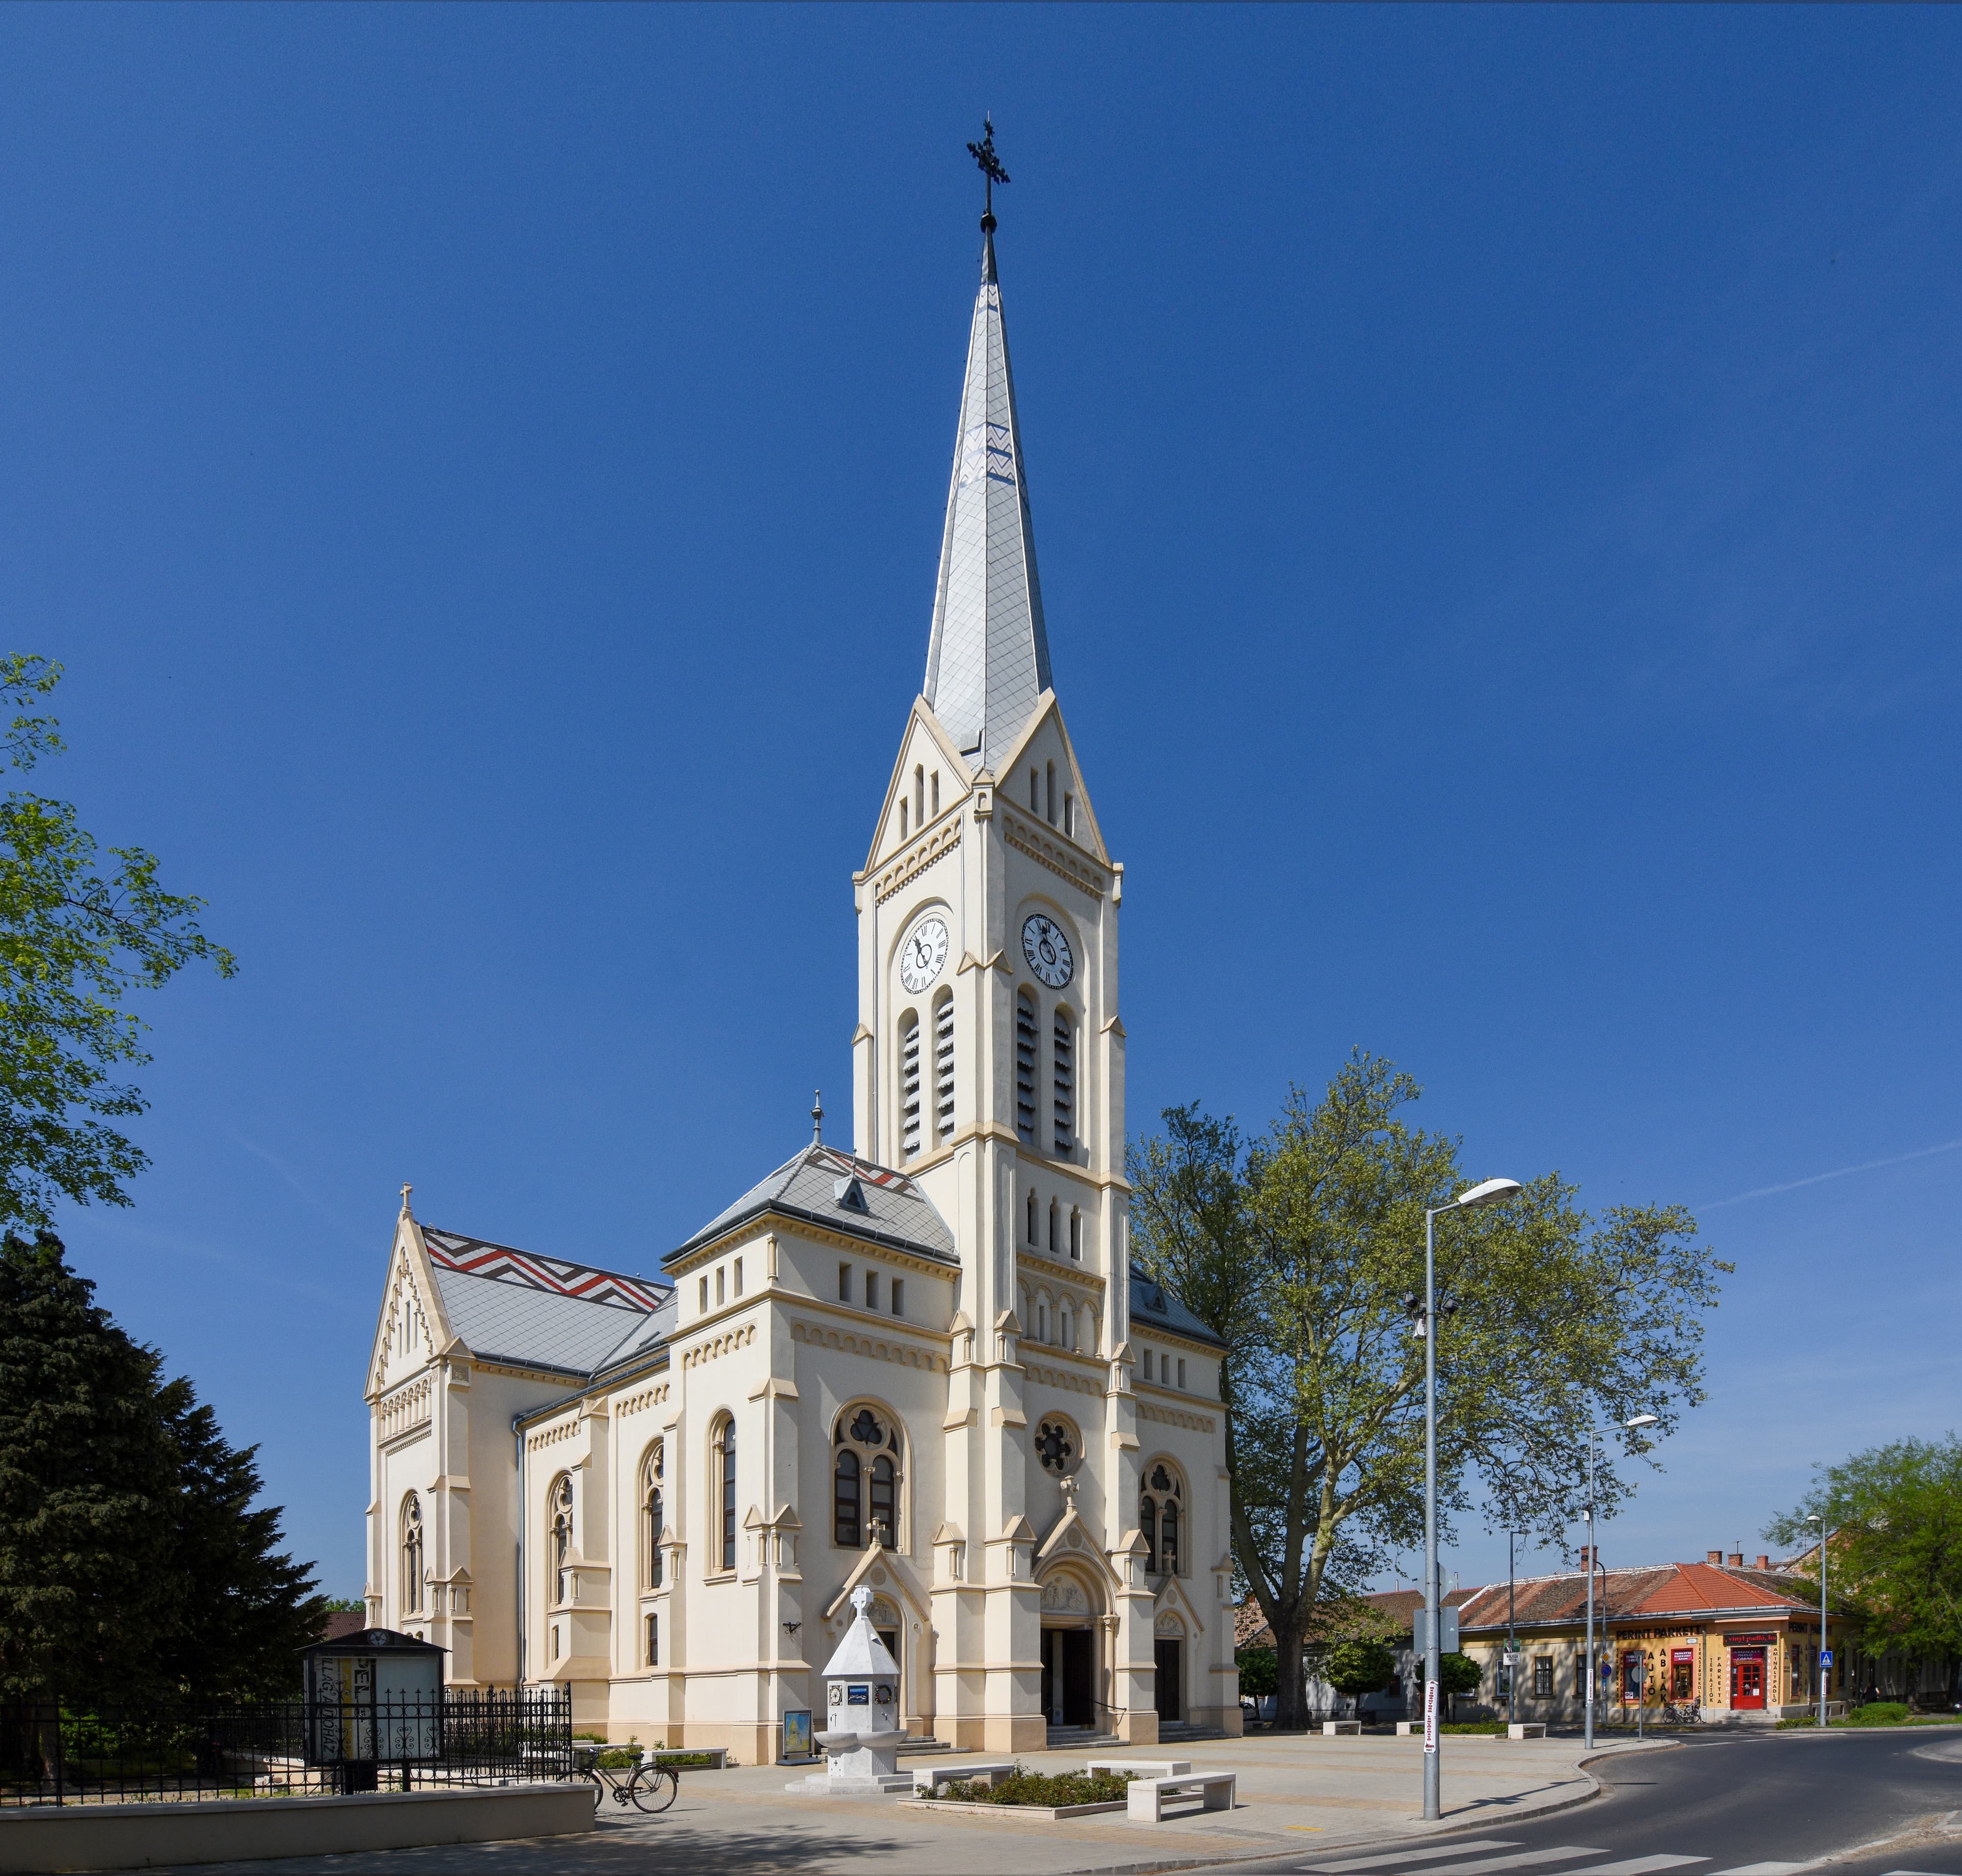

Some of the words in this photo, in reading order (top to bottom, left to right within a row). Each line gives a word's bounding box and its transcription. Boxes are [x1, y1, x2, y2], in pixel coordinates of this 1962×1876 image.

[1617, 1628, 1651, 1640] PERINT
[1654, 1626, 1701, 1638] PARKETT
[322, 1657, 333, 1690] ILLAG
[1648, 1652, 1656, 1696] AJTÓ
